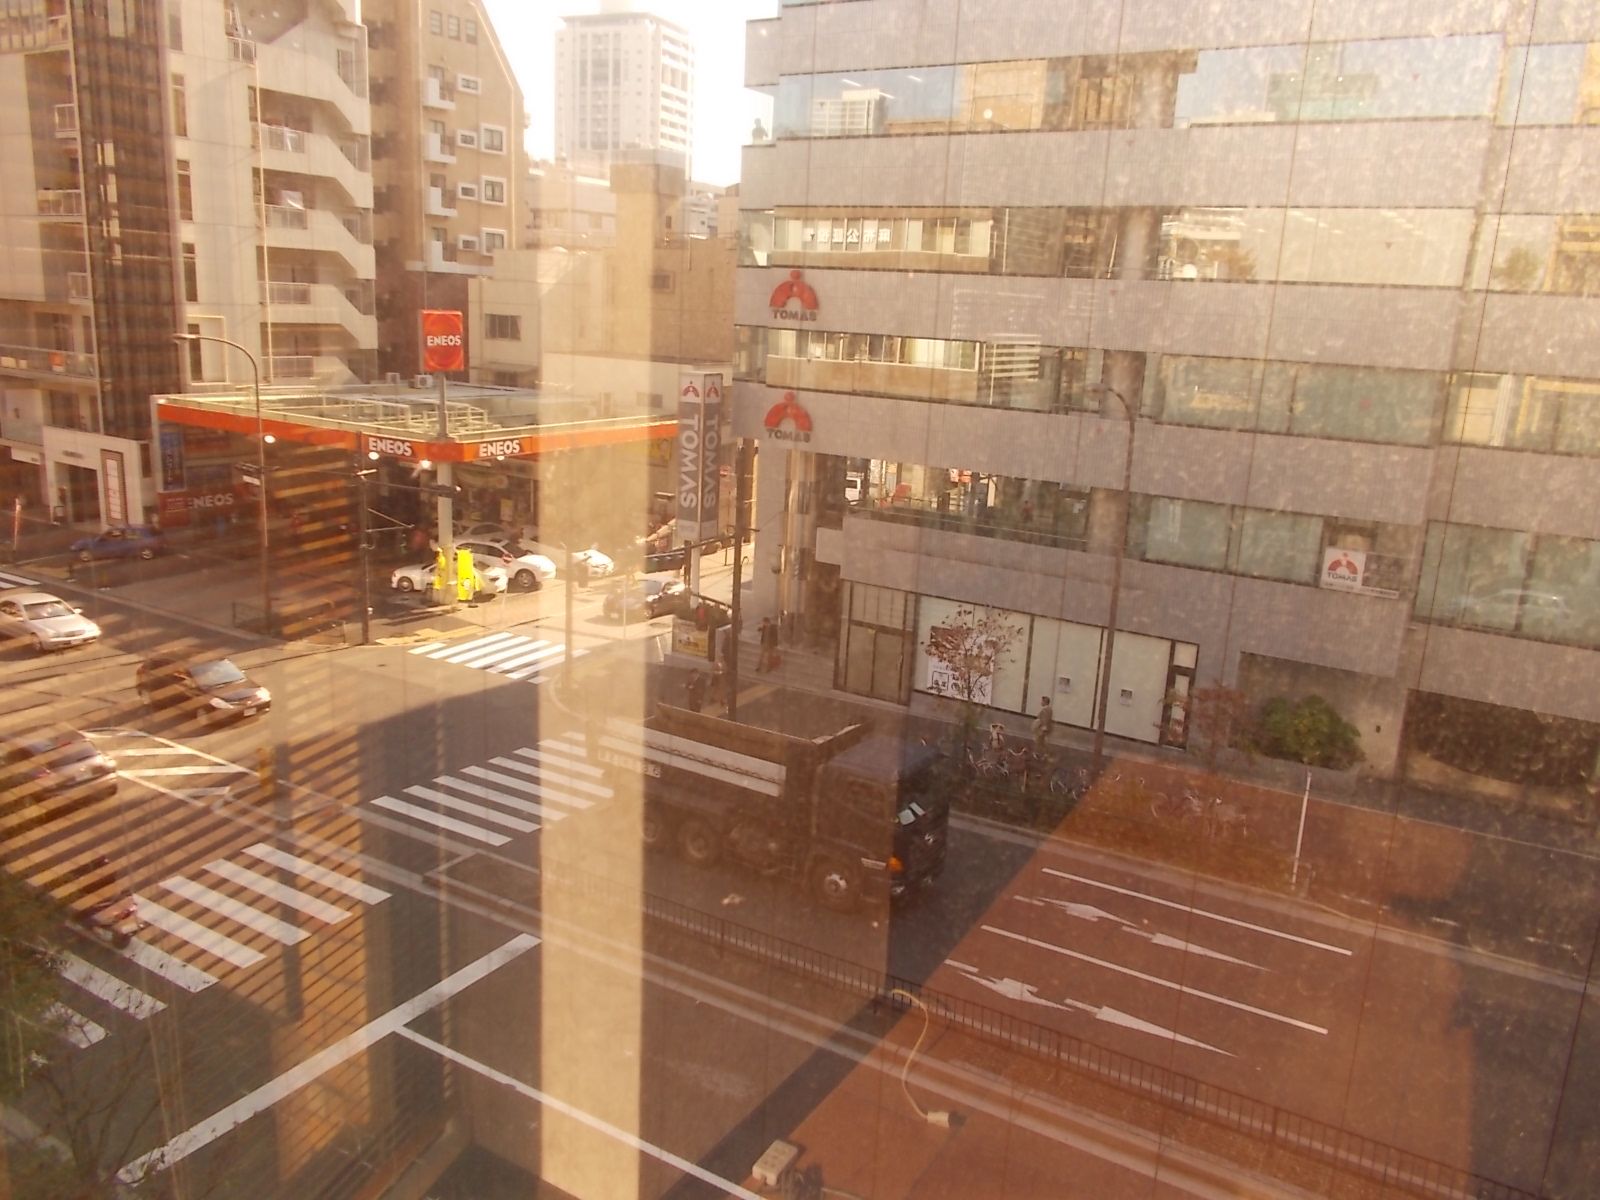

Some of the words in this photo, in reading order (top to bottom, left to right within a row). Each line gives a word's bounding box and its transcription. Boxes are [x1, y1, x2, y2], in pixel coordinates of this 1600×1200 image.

[772, 309, 818, 322] TOMAS
[427, 335, 462, 347] ENEOS
[767, 427, 811, 443] TOMAS
[368, 437, 412, 456] ENEOS
[479, 440, 520, 457] ENEOS
[680, 414, 699, 508] TOMAS
[703, 415, 718, 508] TOMAS
[1328, 571, 1357, 583] TOMAS
